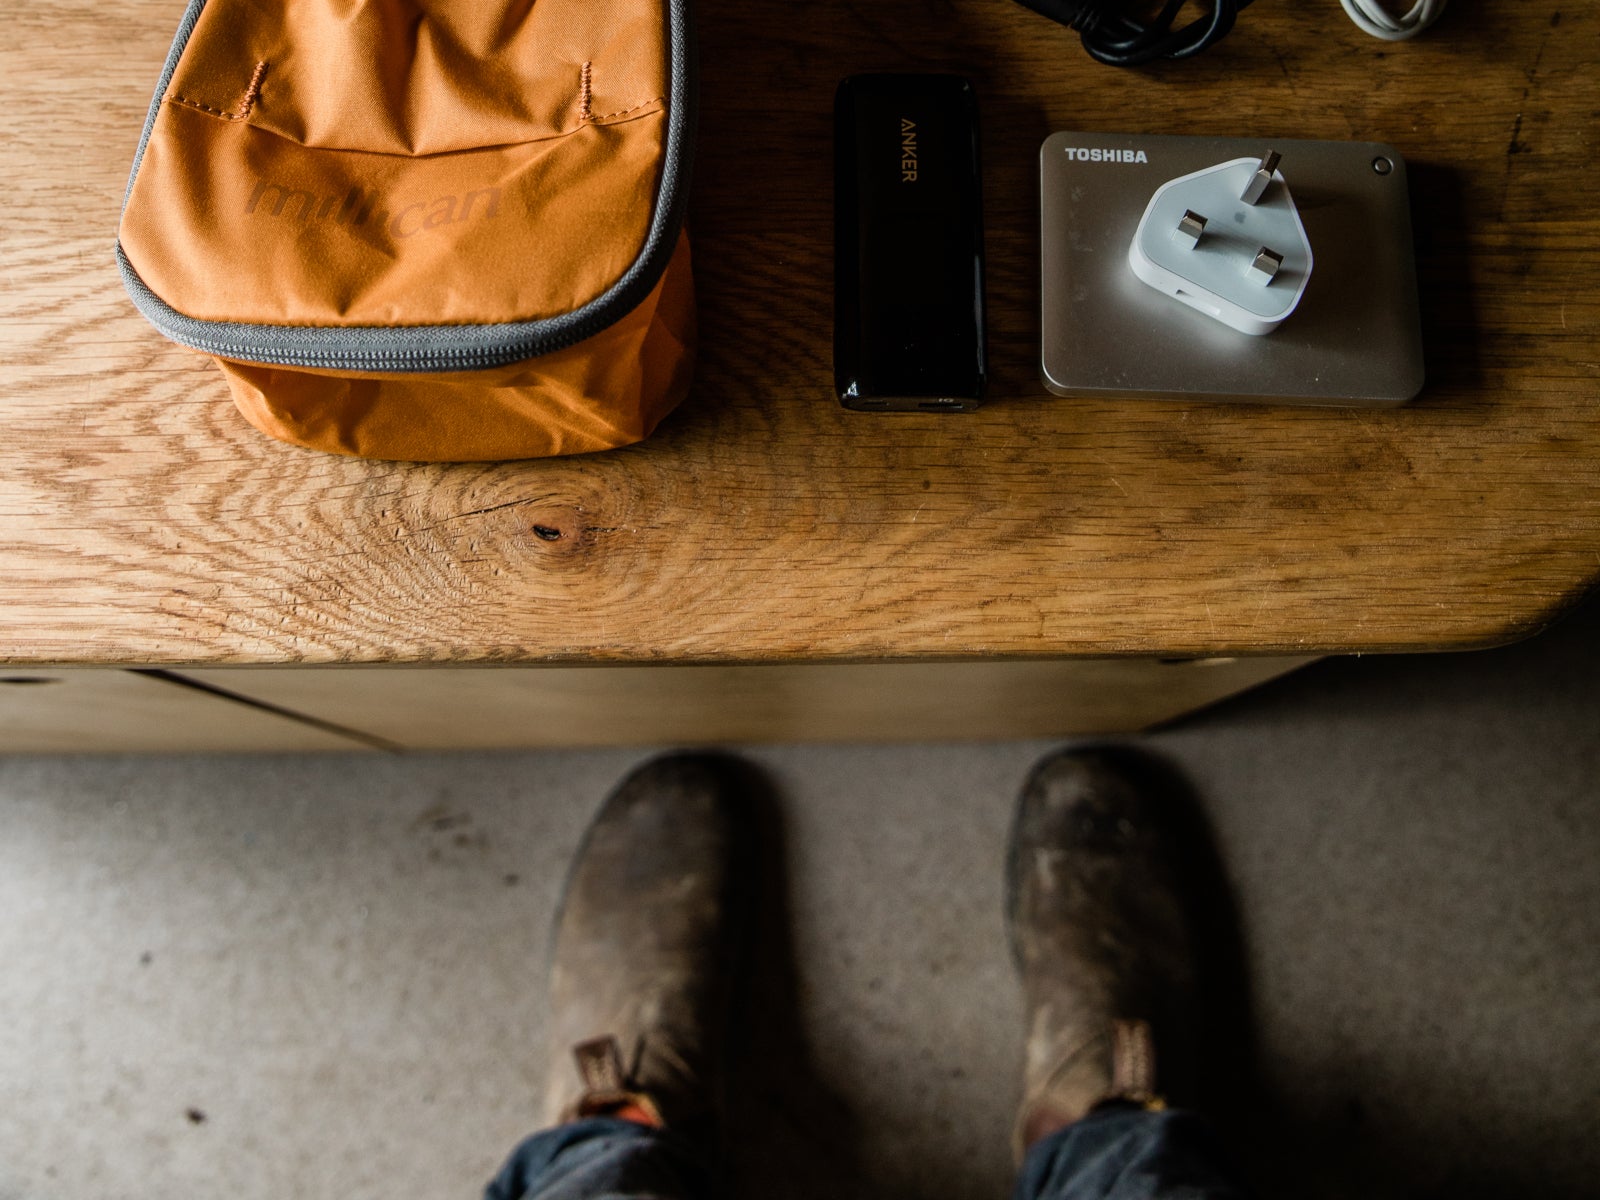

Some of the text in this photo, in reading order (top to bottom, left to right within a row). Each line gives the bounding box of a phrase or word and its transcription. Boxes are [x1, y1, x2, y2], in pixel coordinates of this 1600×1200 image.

[900, 117, 918, 183] ANKER
[1064, 147, 1148, 164] TOSHIBA
[245, 181, 501, 239] millican
